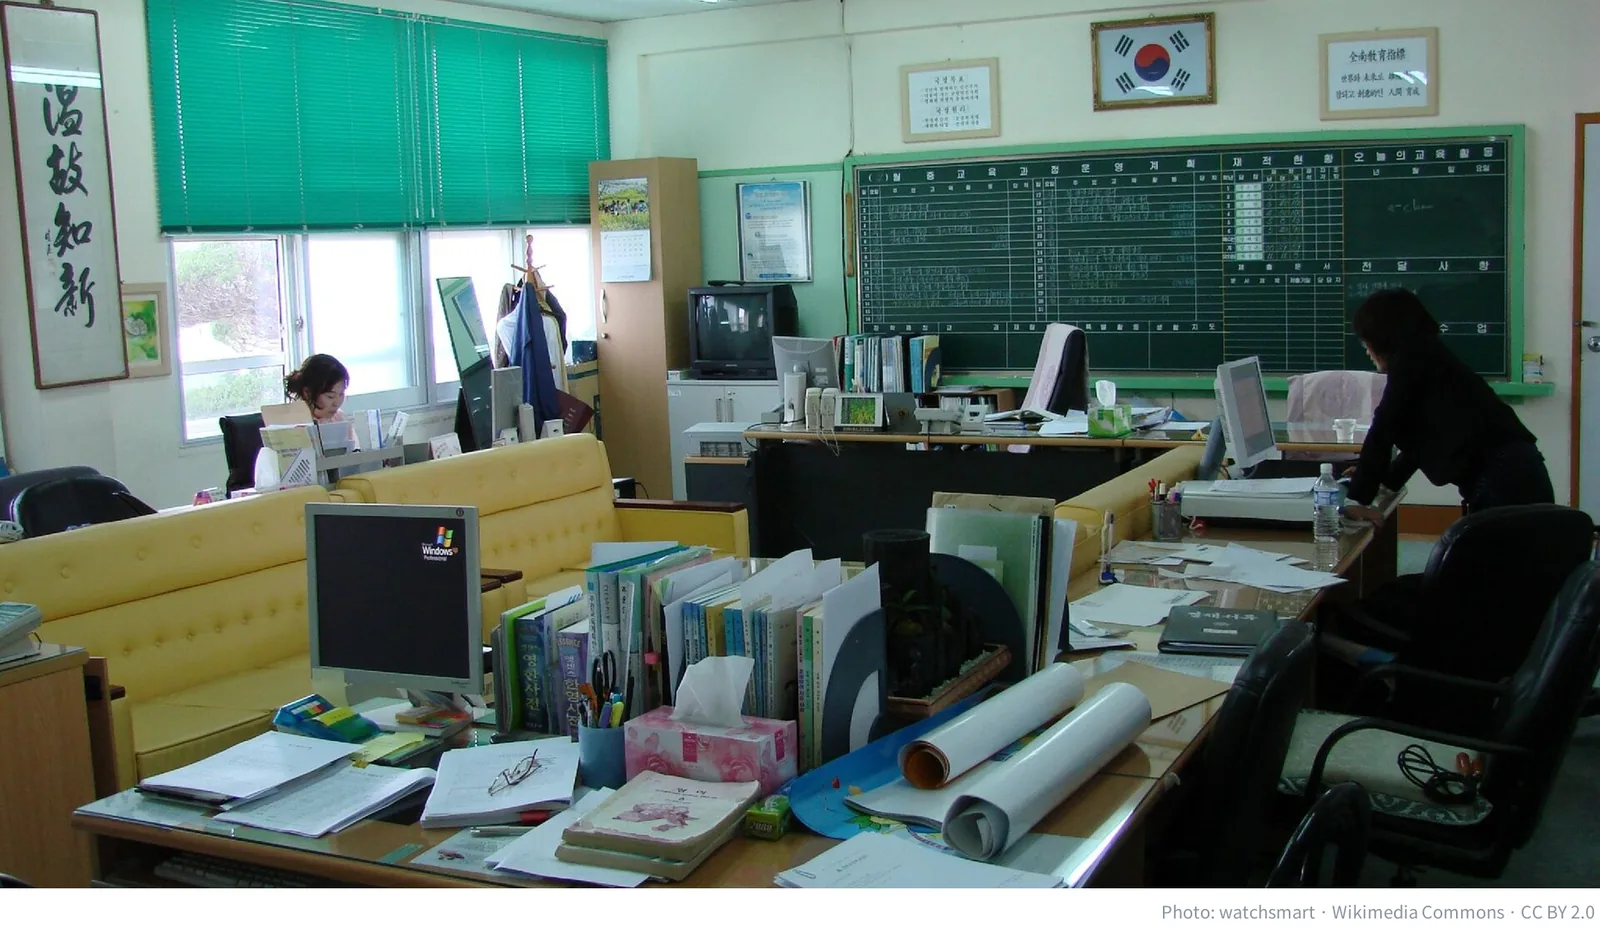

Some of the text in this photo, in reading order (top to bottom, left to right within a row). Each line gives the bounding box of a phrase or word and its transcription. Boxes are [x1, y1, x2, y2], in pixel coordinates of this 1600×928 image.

[1440, 324, 1486, 333] 수 업
[422, 546, 453, 556] Windows
